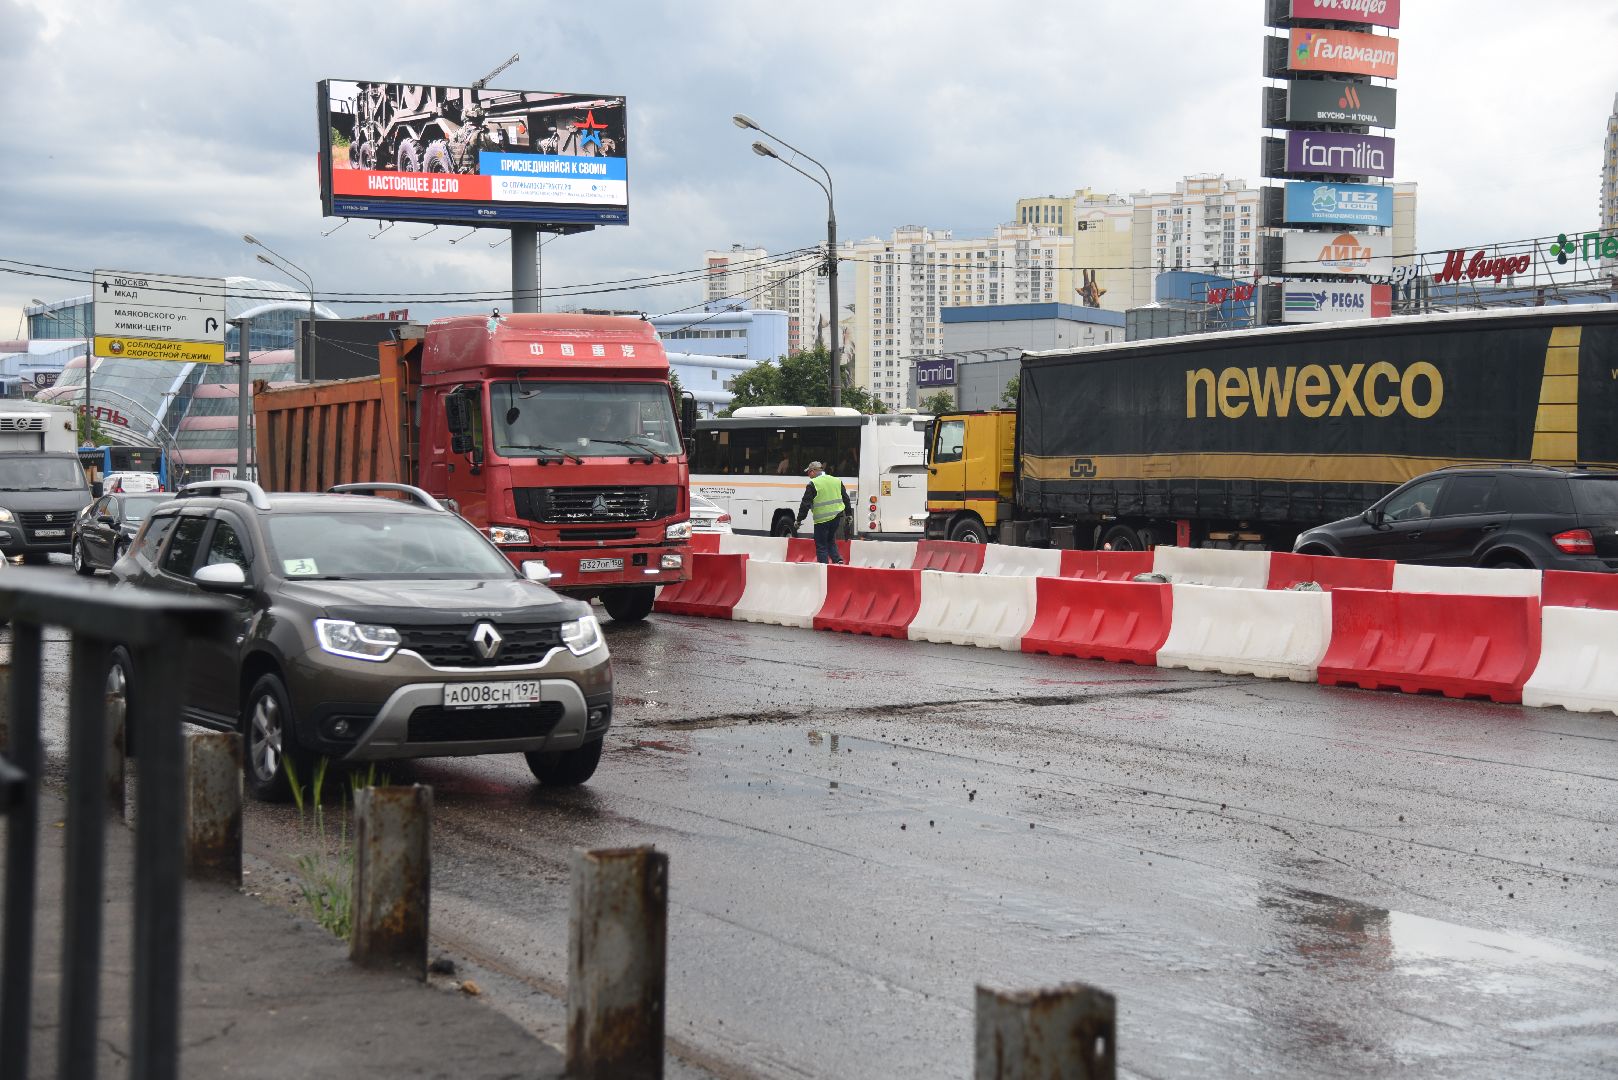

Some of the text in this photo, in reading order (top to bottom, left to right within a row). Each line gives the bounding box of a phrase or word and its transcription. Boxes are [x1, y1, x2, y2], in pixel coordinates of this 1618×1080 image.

[1313, 38, 1395, 69] Галамарт
[1317, 111, 1345, 120] ВКУСНО
[1351, 113, 1357, 121] И
[1358, 114, 1378, 123] ТОЧКА
[1302, 138, 1384, 170] familia
[501, 159, 607, 175] ПРИСОЕДИНЯЙСЯ К СВОИМ
[368, 175, 459, 193] НАСТОЯЩЕЕ ДЕЛО
[1339, 191, 1378, 203] TEZ
[1317, 245, 1371, 263] ЛИГА
[1434, 248, 1530, 283] М.видео
[114, 278, 149, 287] МОСКВА
[114, 290, 138, 299] МКАД
[1331, 292, 1364, 308] PEGAS
[114, 309, 189, 322] МАЯКОВСКОГО ул.
[114, 322, 172, 332] ХИМКИ-ЦЕНТР
[126, 341, 182, 351] СОБЛЮДАЙТЕ
[530, 343, 636, 358] 中国重汽
[126, 349, 180, 359] СКОРОСТНОЙ
[1185, 360, 1444, 420] newexco
